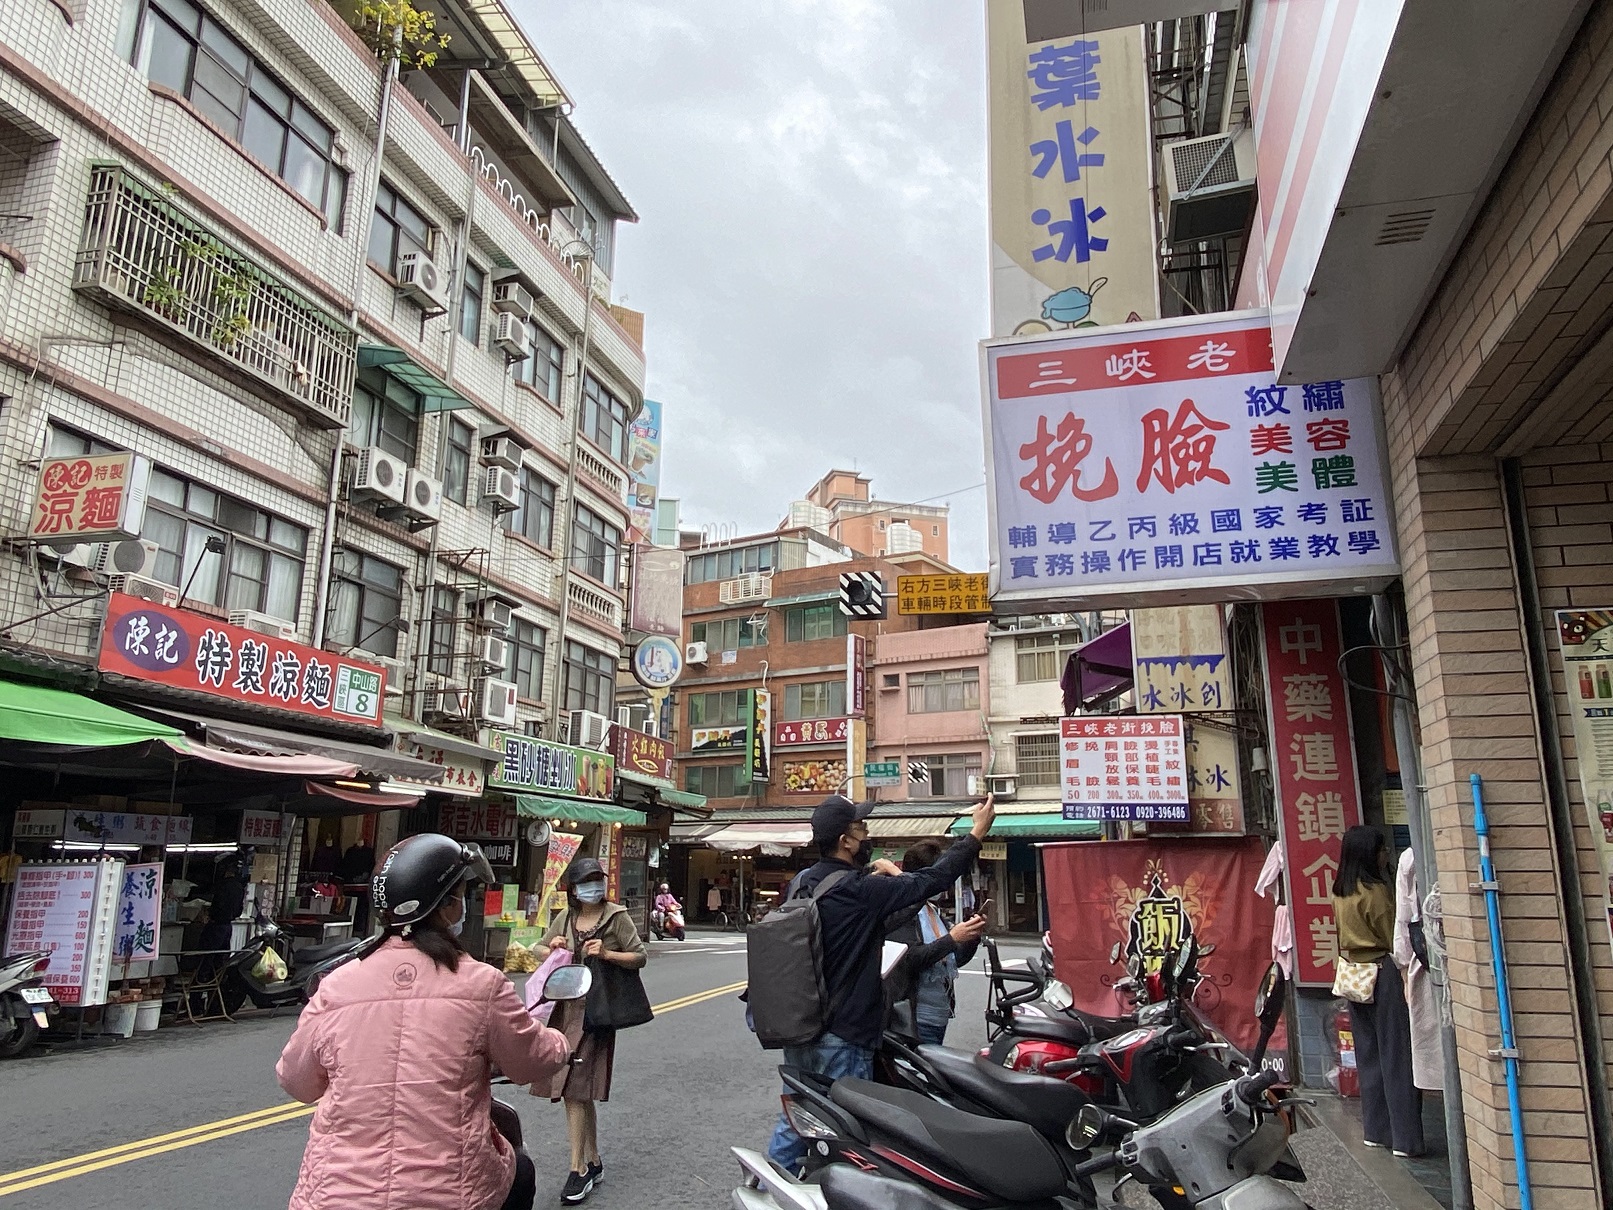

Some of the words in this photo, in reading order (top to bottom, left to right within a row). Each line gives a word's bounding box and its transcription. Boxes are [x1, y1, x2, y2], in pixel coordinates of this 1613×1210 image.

[1027, 40, 1109, 264] 葉水冰
[1029, 340, 1275, 388] 三峽老
[1019, 398, 1231, 504] 挽臉
[1249, 417, 1351, 456] 美容
[47, 465, 89, 489] 陳記
[94, 463, 124, 481] 特製
[1255, 454, 1358, 494] 美體
[34, 486, 123, 533] 涼麵
[1008, 498, 1375, 549] 輔導乙丙級國家考証
[1010, 530, 1380, 580] 實務操作開店就業教學
[125, 616, 178, 664] 陳記
[195, 628, 332, 709] 特製涼麵
[352, 672, 378, 692] 中山路
[355, 694, 369, 713] 8
[1067, 721, 1174, 735] 三峽老街挽臉
[1068, 790, 1080, 799] 50
[1088, 790, 1100, 799] 200
[1278, 617, 1346, 968] 中藥連鎖企業
[440, 803, 517, 838] 家吉水電行
[1087, 806, 1130, 818] 2671-6123
[1135, 806, 1186, 819] 0920-396486
[80, 891, 91, 899] 300
[134, 868, 157, 953] 涼麵
[77, 921, 88, 929] 150
[78, 910, 89, 919] 200
[72, 953, 83, 961] 200
